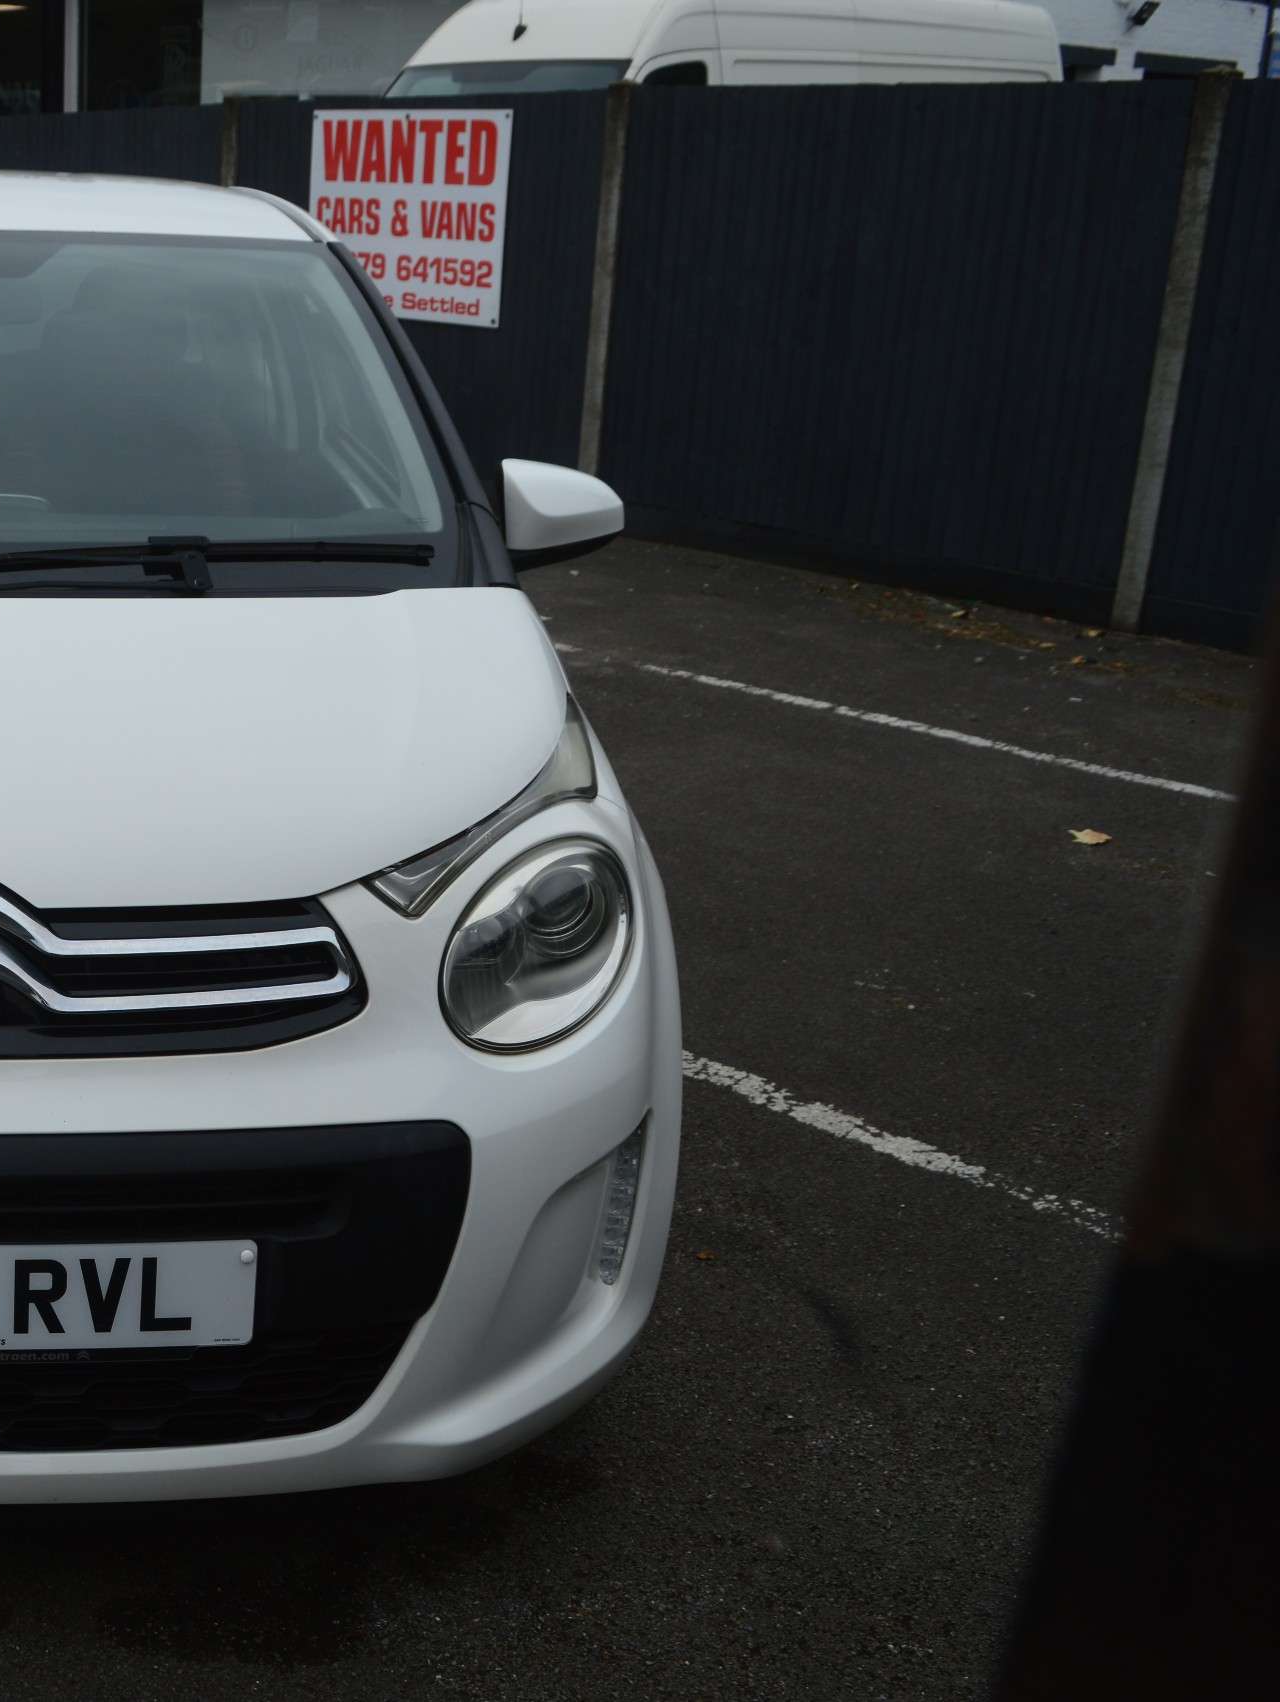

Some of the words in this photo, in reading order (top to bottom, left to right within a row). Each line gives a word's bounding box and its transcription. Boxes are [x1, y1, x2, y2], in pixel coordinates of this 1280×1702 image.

[322, 119, 499, 187] WANTED
[317, 196, 382, 236] CARS
[391, 198, 410, 237] &
[420, 200, 497, 243] VANS
[396, 254, 494, 289] 641592
[401, 292, 480, 318] Settled
[13, 1256, 194, 1335] RVL
